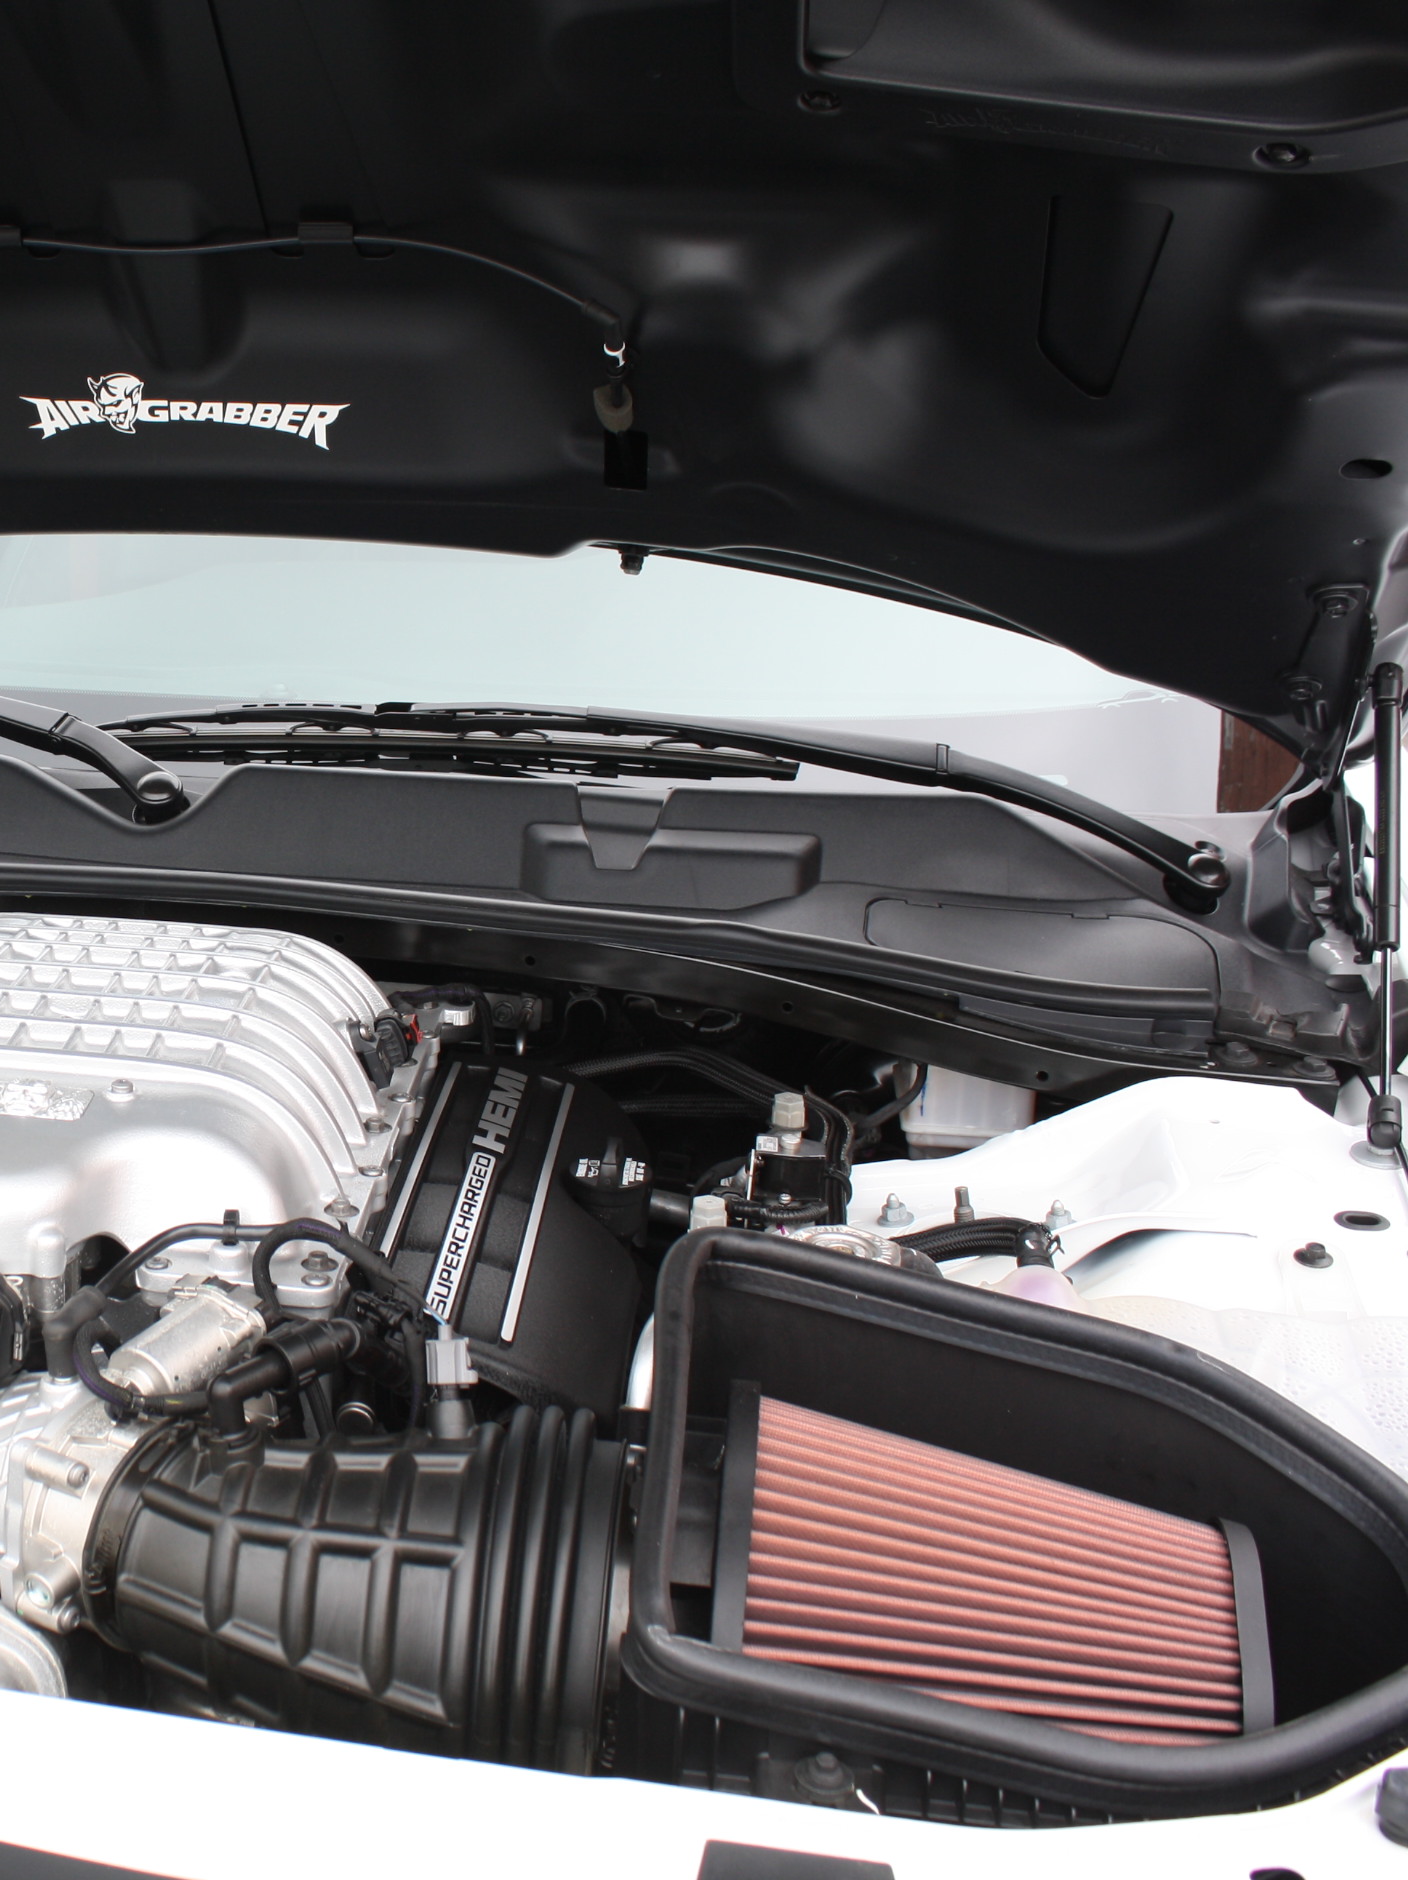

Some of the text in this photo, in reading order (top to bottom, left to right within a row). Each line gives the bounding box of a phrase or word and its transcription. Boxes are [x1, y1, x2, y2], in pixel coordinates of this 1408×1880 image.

[19, 396, 350, 450] AIR GRABBER
[430, 1066, 529, 1316] SUPERCHARGED HEMI
